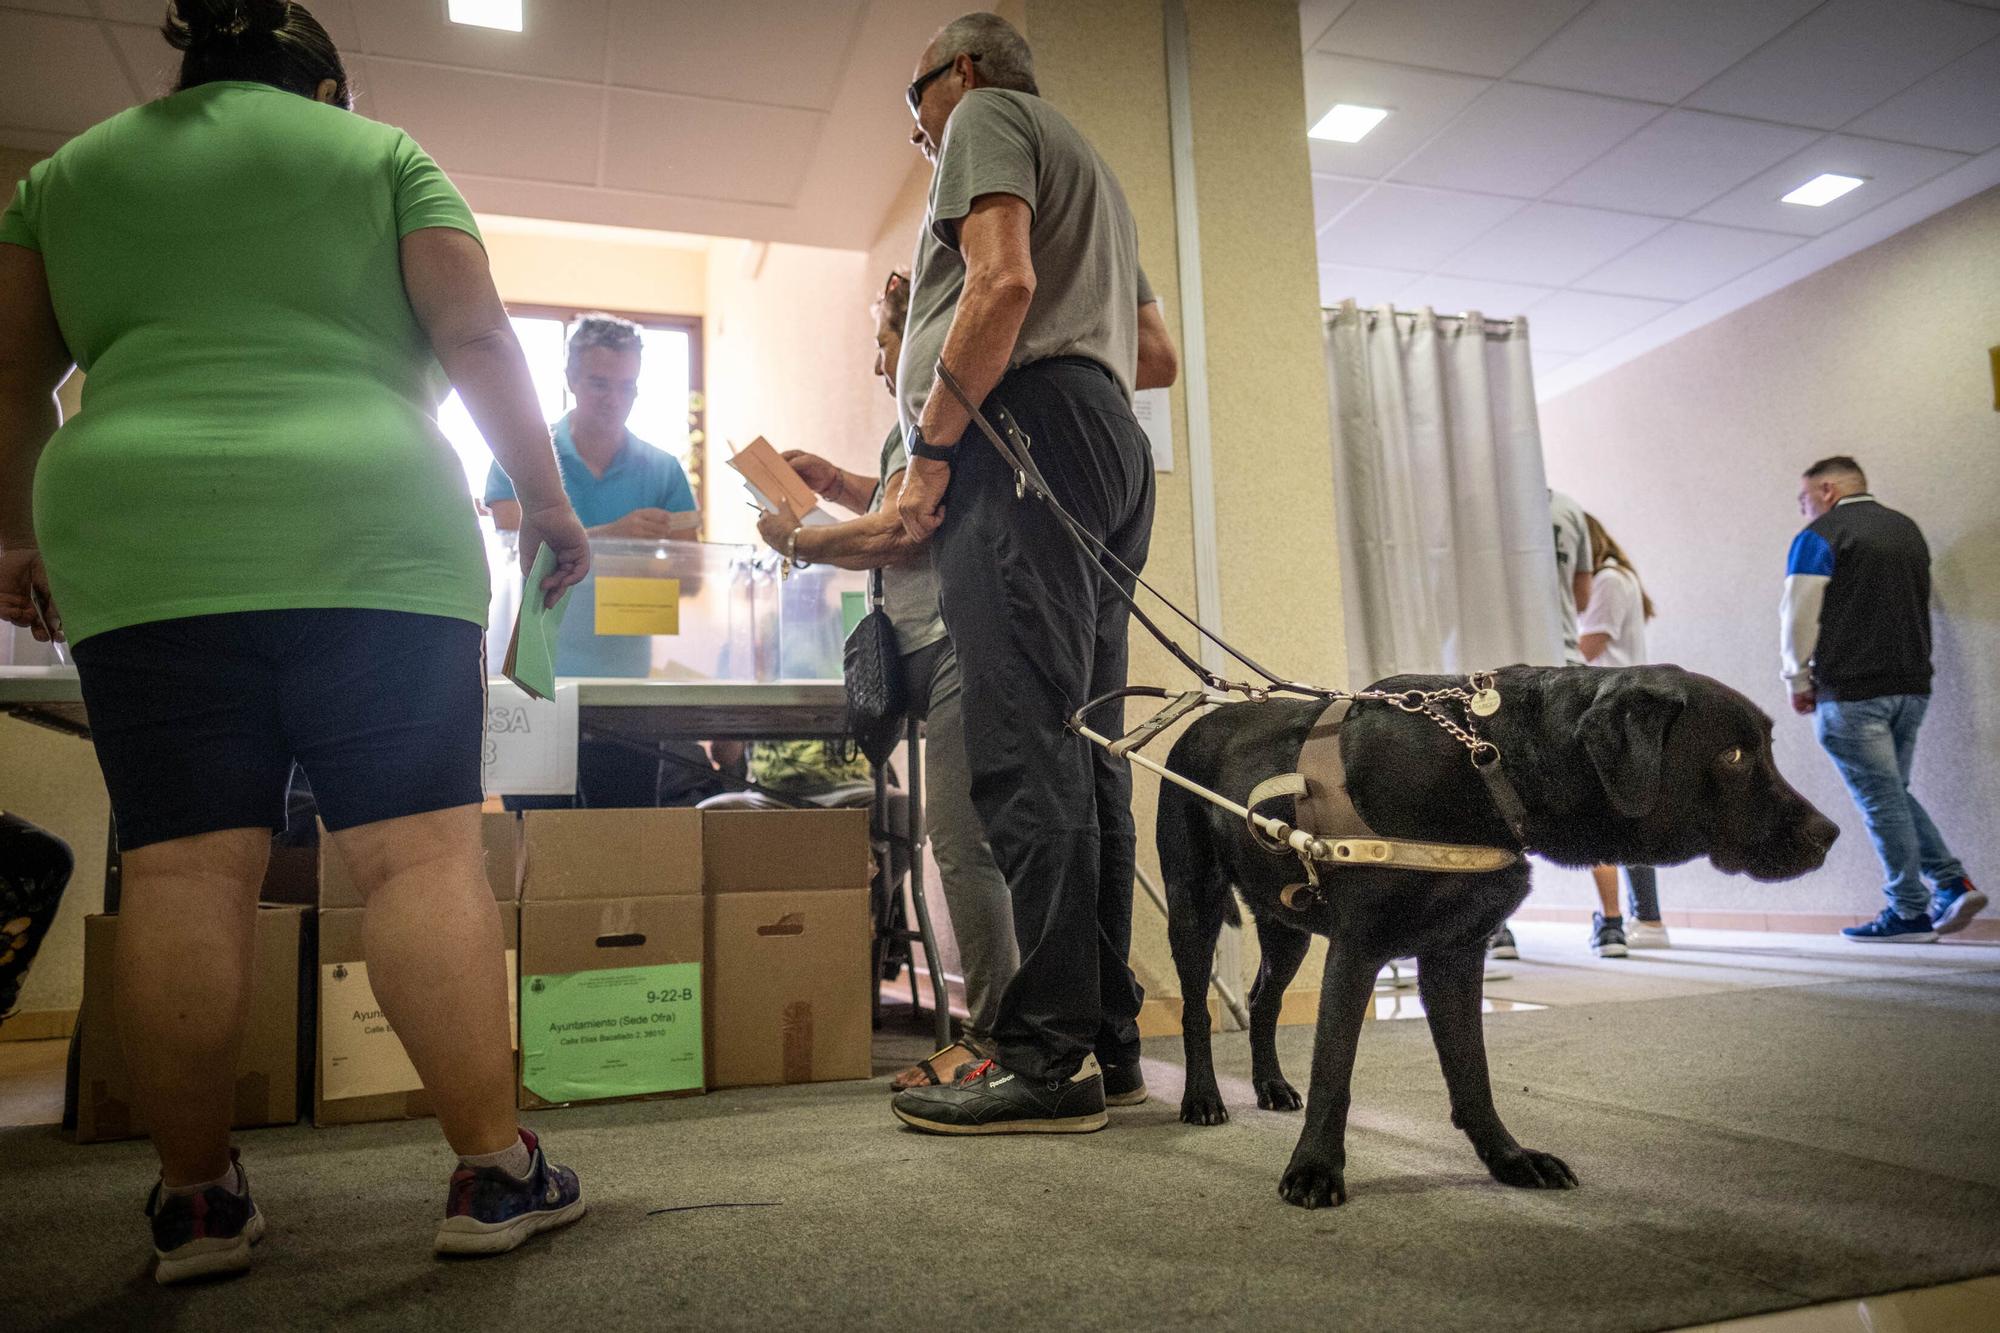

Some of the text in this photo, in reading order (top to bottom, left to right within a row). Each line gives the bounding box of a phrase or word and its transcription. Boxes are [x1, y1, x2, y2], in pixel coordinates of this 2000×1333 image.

[488, 706, 531, 733] SA
[646, 987, 693, 1004] 9-22-B
[549, 1012, 676, 1034] Ayuntamiento (Sede Ofra)
[989, 1074, 1015, 1088] Reebok
